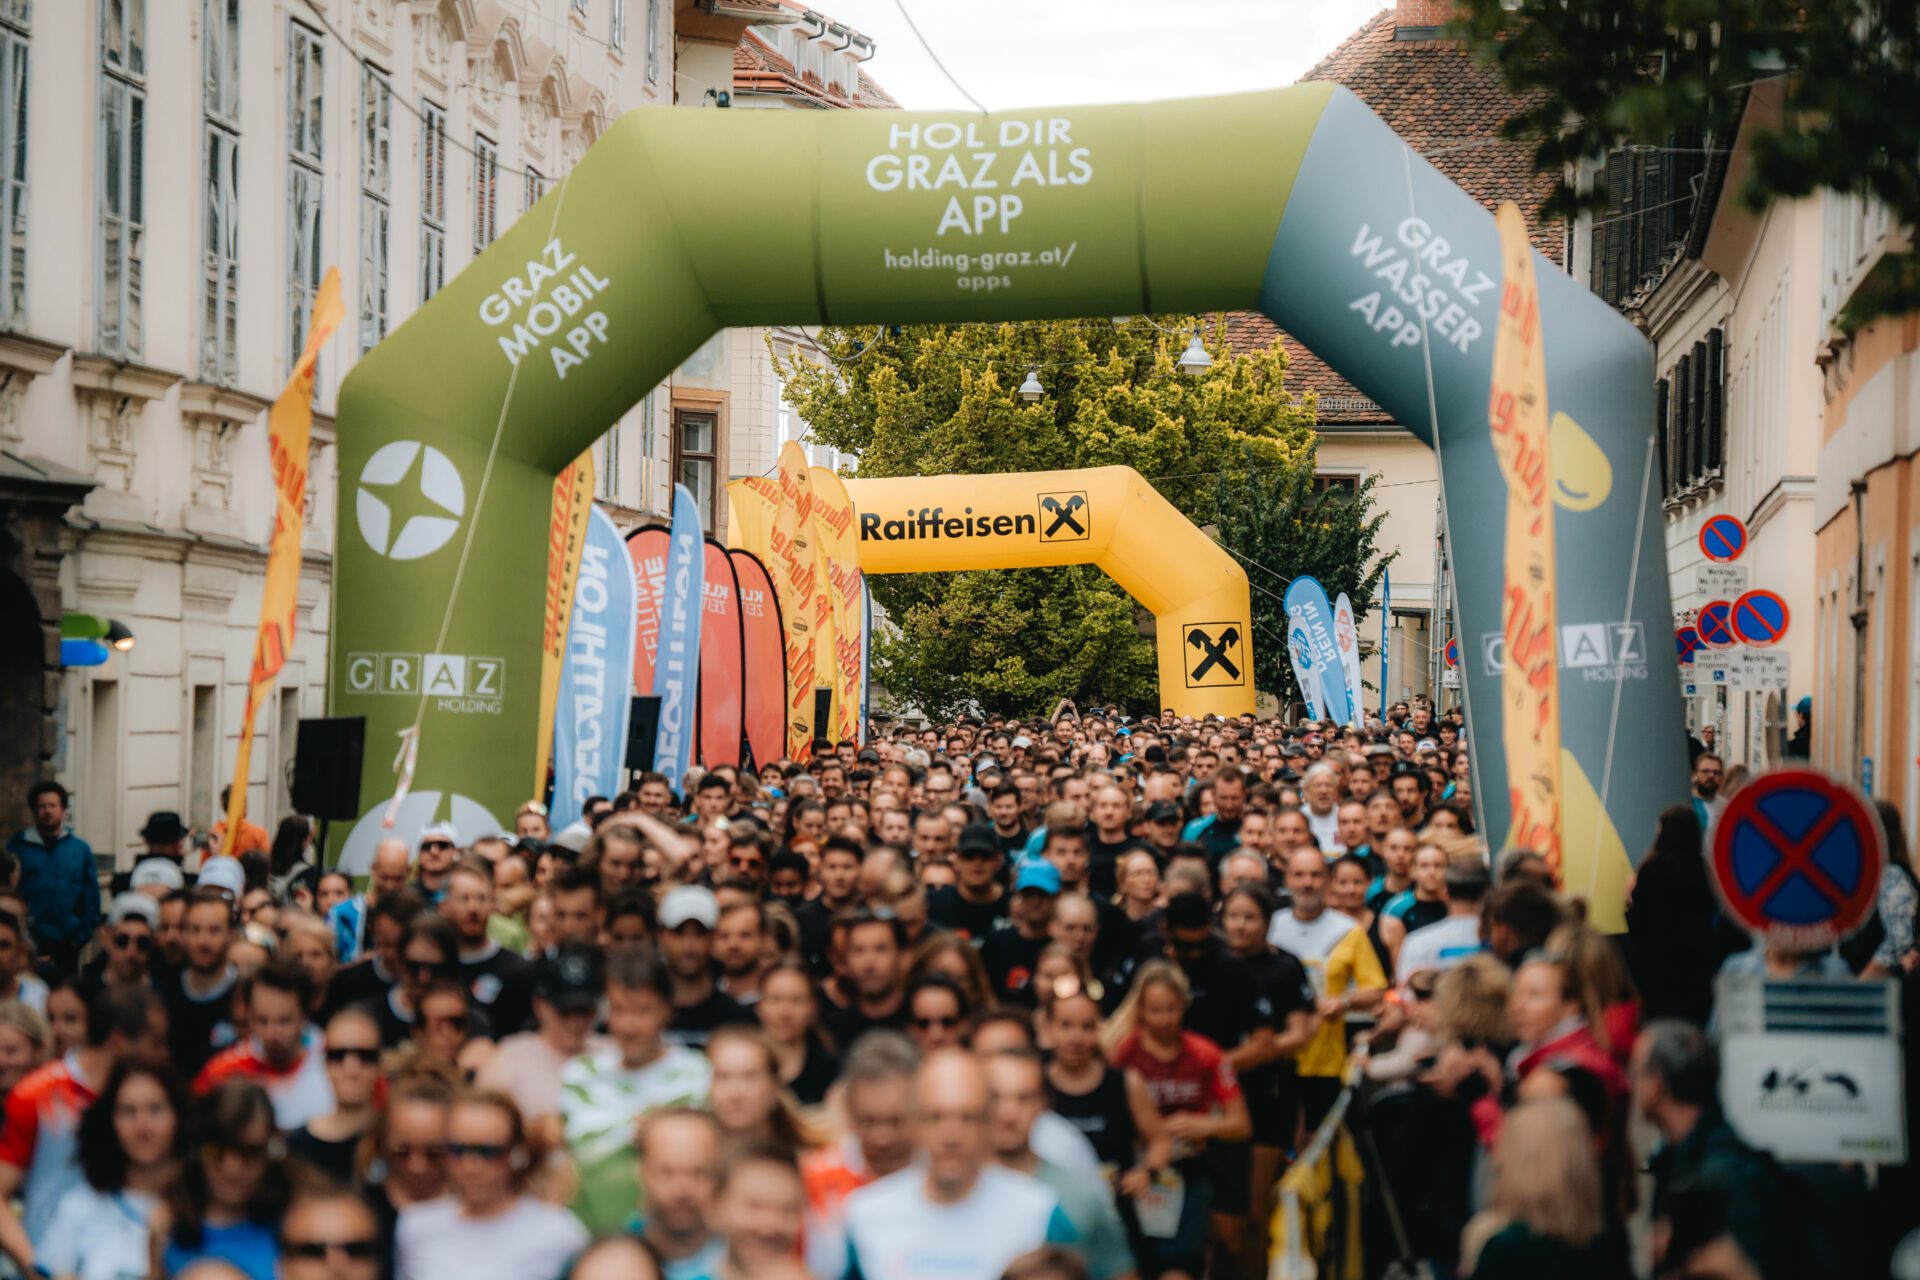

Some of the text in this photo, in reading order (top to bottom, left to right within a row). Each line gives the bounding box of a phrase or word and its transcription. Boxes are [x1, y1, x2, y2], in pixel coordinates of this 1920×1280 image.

[889, 118, 1073, 151] HOL DIR
[865, 147, 1093, 191] GRAZ ALS
[936, 194, 1023, 236] APP
[884, 241, 1078, 272] holding-graz.at/
[1397, 216, 1497, 306] GRAZ
[479, 237, 576, 325] GRAZ
[956, 274, 1011, 292] apps
[1351, 223, 1483, 354] WASSER
[497, 265, 610, 366] MOBIL
[1348, 291, 1423, 348] APP
[550, 310, 609, 380] APP
[860, 506, 1035, 541] Raiffeisen
[553, 469, 585, 659] STEIERMARK
[348, 657, 498, 695] GRAZ
[1582, 664, 1649, 681] HOLDING
[437, 700, 502, 715] HOLDING
